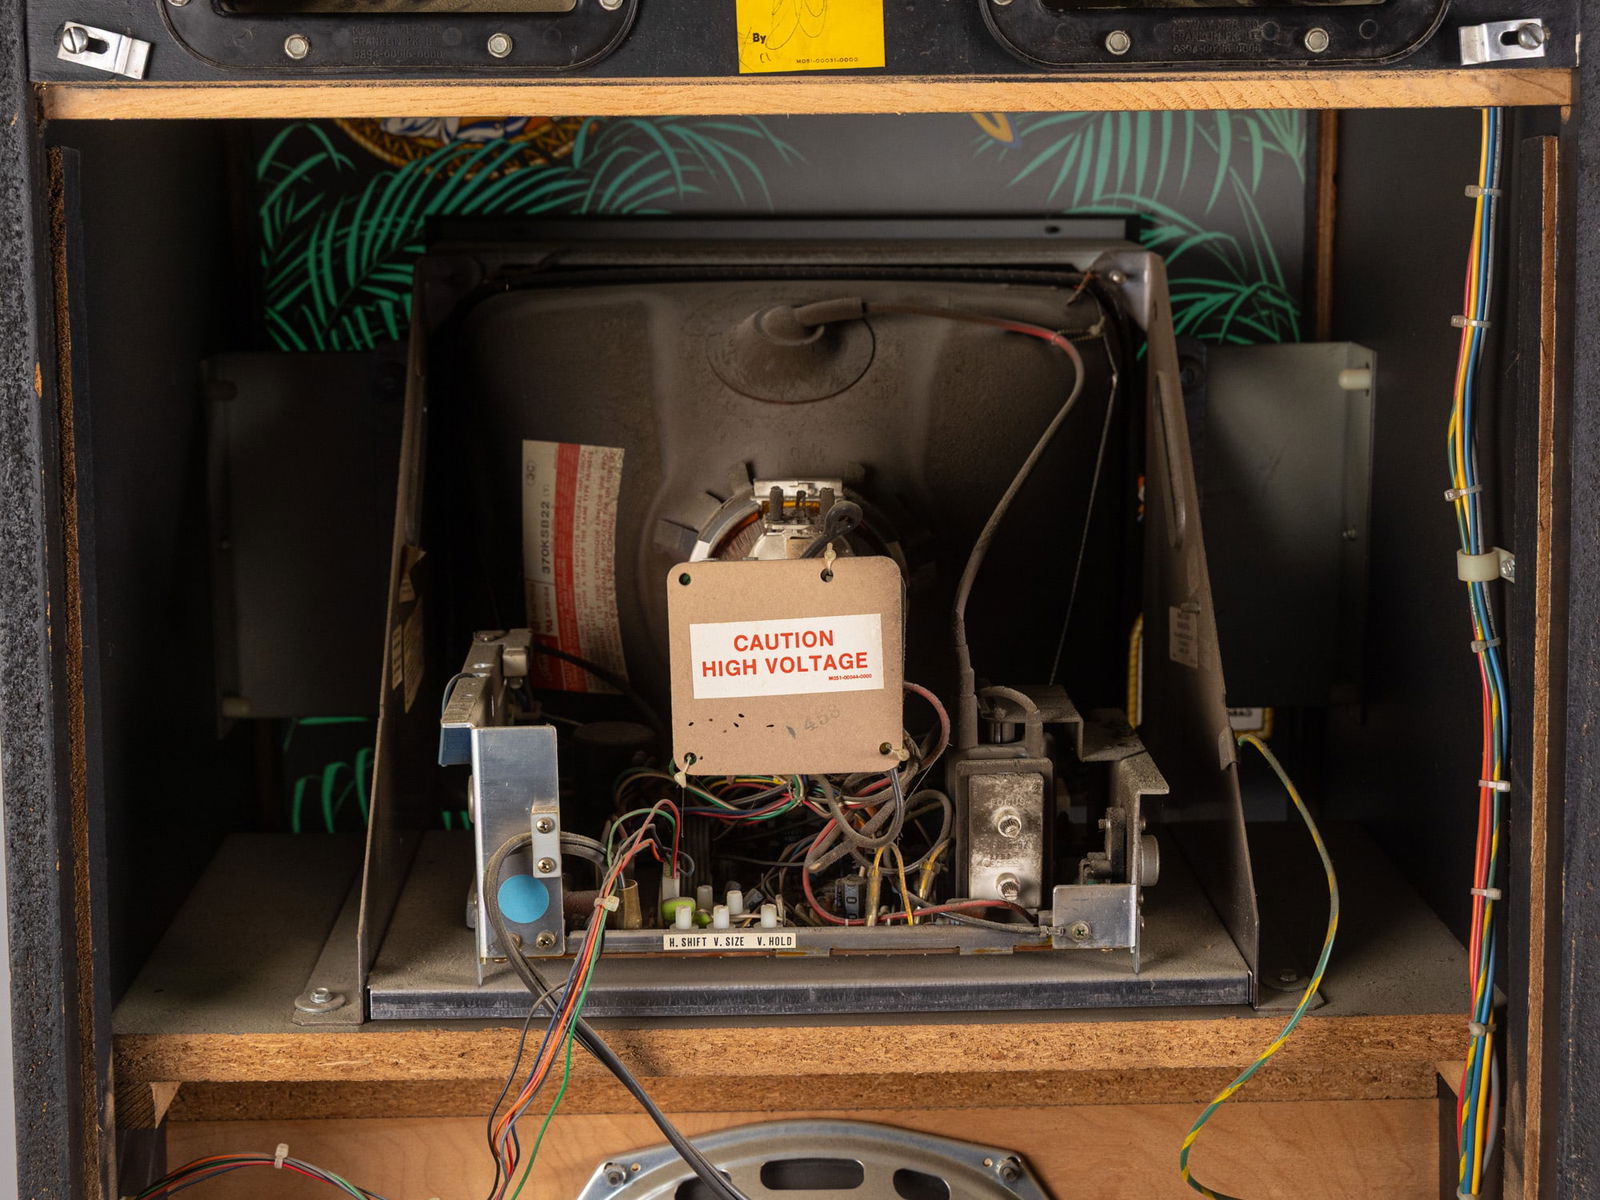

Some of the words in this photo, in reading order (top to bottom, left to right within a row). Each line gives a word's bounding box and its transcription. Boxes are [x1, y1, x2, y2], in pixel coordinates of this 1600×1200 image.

[752, 32, 767, 44] By
[733, 630, 833, 652] CAUTION
[702, 659, 757, 677] HIGH
[765, 652, 868, 674] VOLTAGE
[989, 796, 1026, 808] FOCUS
